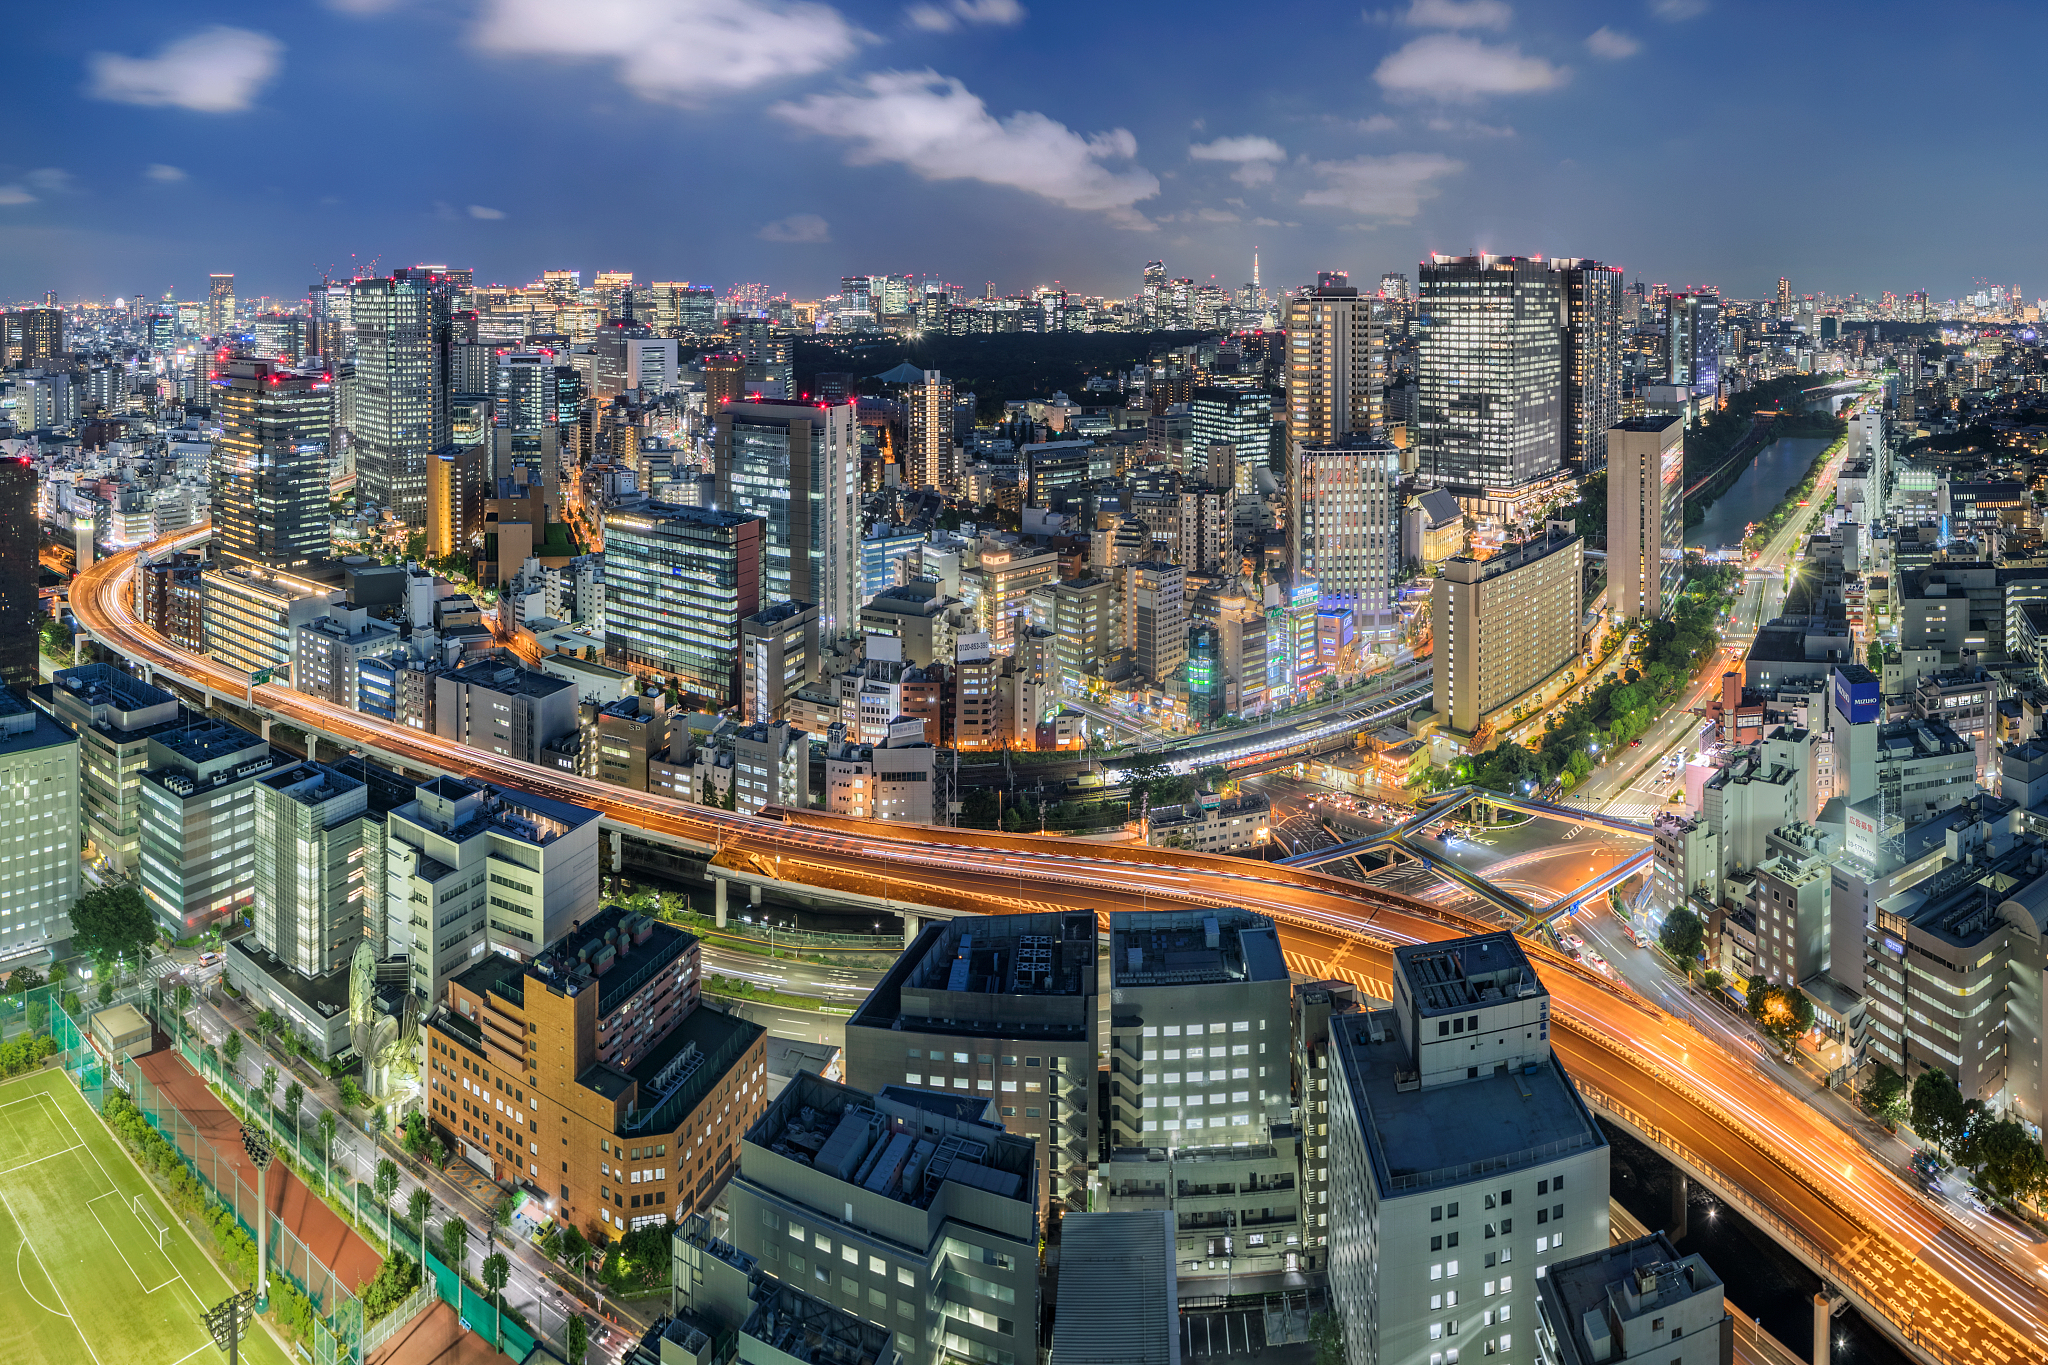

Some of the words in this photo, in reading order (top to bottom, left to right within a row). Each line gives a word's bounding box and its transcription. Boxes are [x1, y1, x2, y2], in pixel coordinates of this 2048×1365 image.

[1836, 681, 1850, 704] MIZUHO
[1854, 697, 1877, 705] MIZUHO
[1849, 815, 1874, 834] 広告募集
[1868, 1250, 2011, 1364] 追突注意
